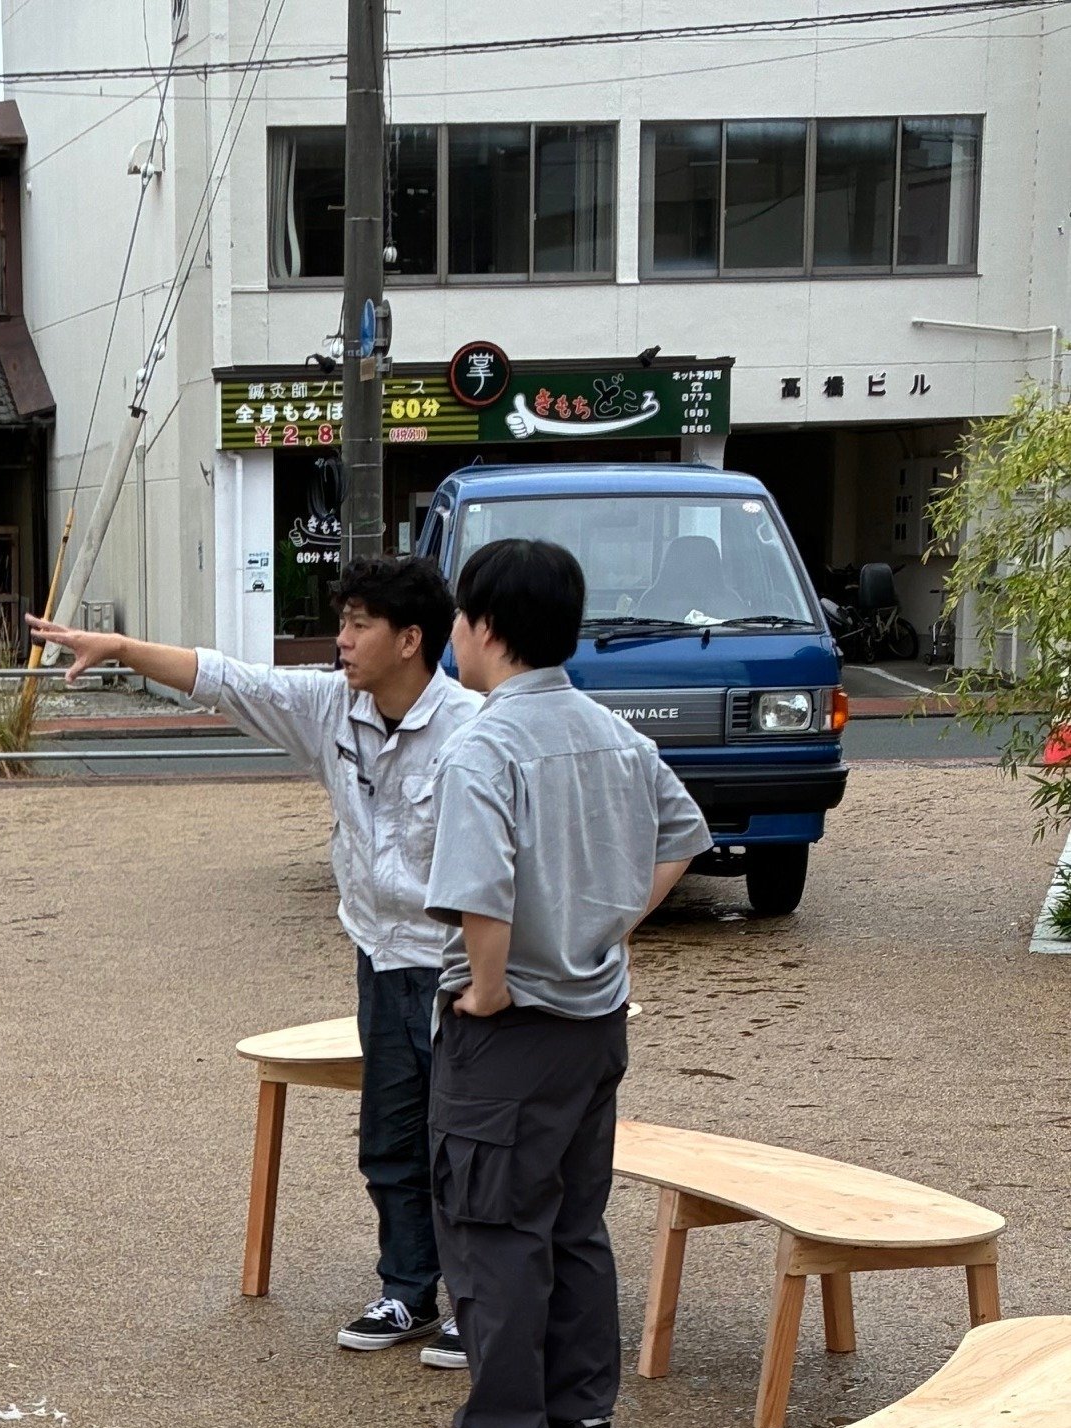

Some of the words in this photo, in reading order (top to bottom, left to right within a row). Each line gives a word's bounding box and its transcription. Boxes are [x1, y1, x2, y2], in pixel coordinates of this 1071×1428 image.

[466, 352, 494, 396] 掌
[672, 370, 722, 381] ネット予約可
[534, 373, 660, 420] きもちどころ
[390, 398, 441, 420] 60分
[610, 708, 646, 719] OWN
[647, 707, 680, 719] ACE
